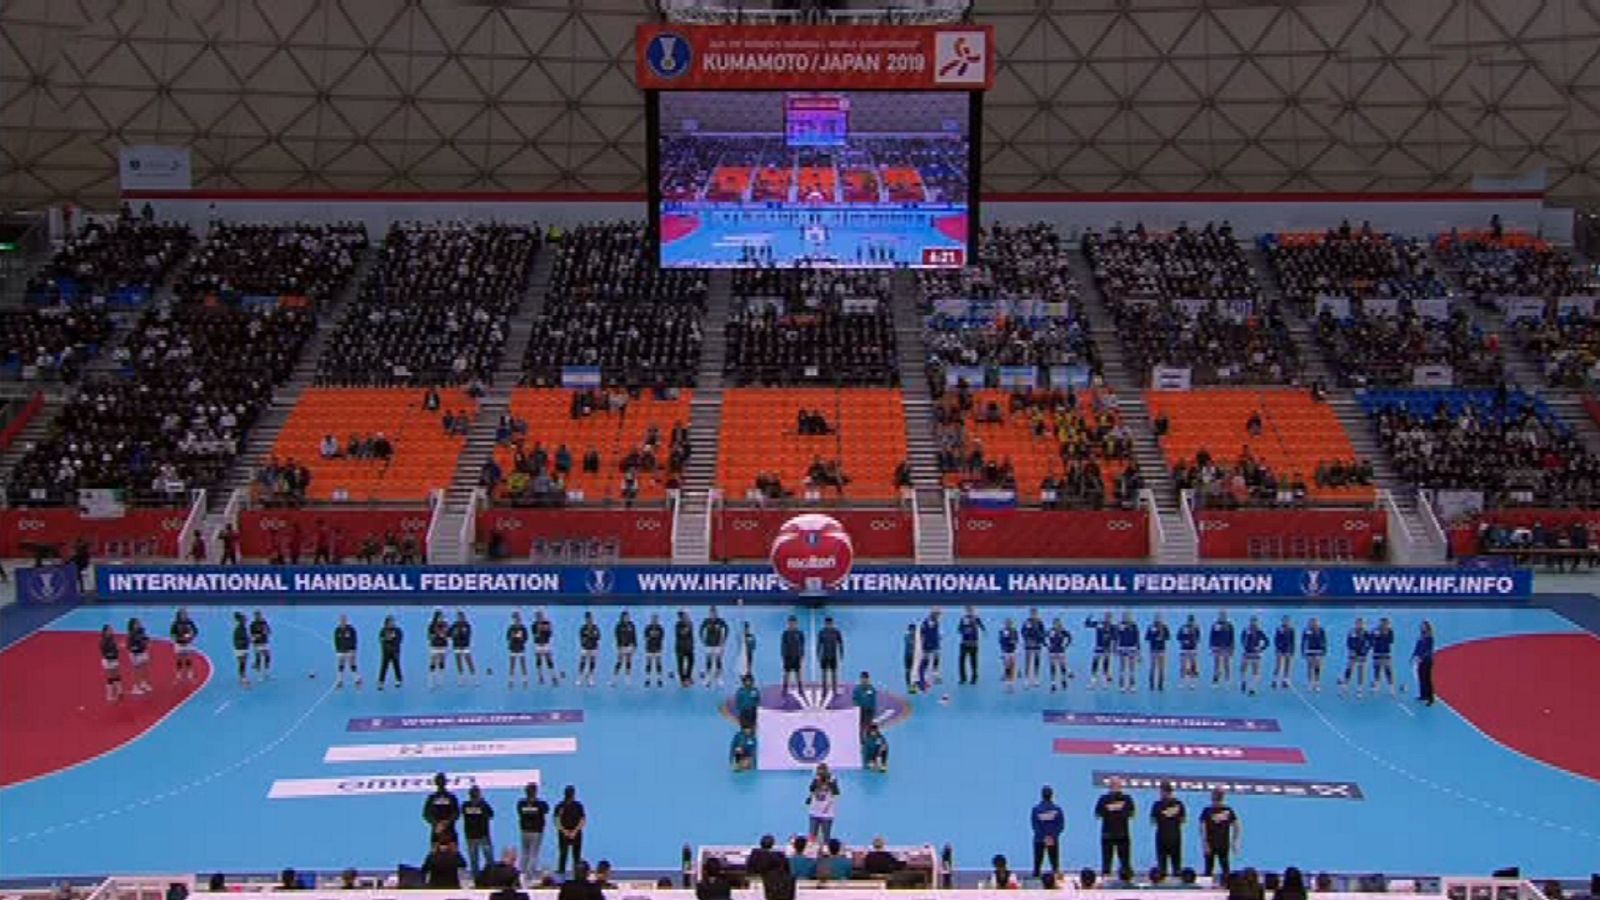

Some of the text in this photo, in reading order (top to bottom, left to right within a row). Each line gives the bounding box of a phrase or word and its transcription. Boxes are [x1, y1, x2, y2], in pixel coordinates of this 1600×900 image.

[703, 52, 926, 71] KUMAMOTO/JAPAN 2019
[109, 573, 560, 591] INTERNATIONAL HANDBALL FEDERATION
[834, 573, 1273, 591] NTERNATIONAL HANDBALL FEDERATION
[1351, 575, 1514, 594] WWW.IHF.INFO
